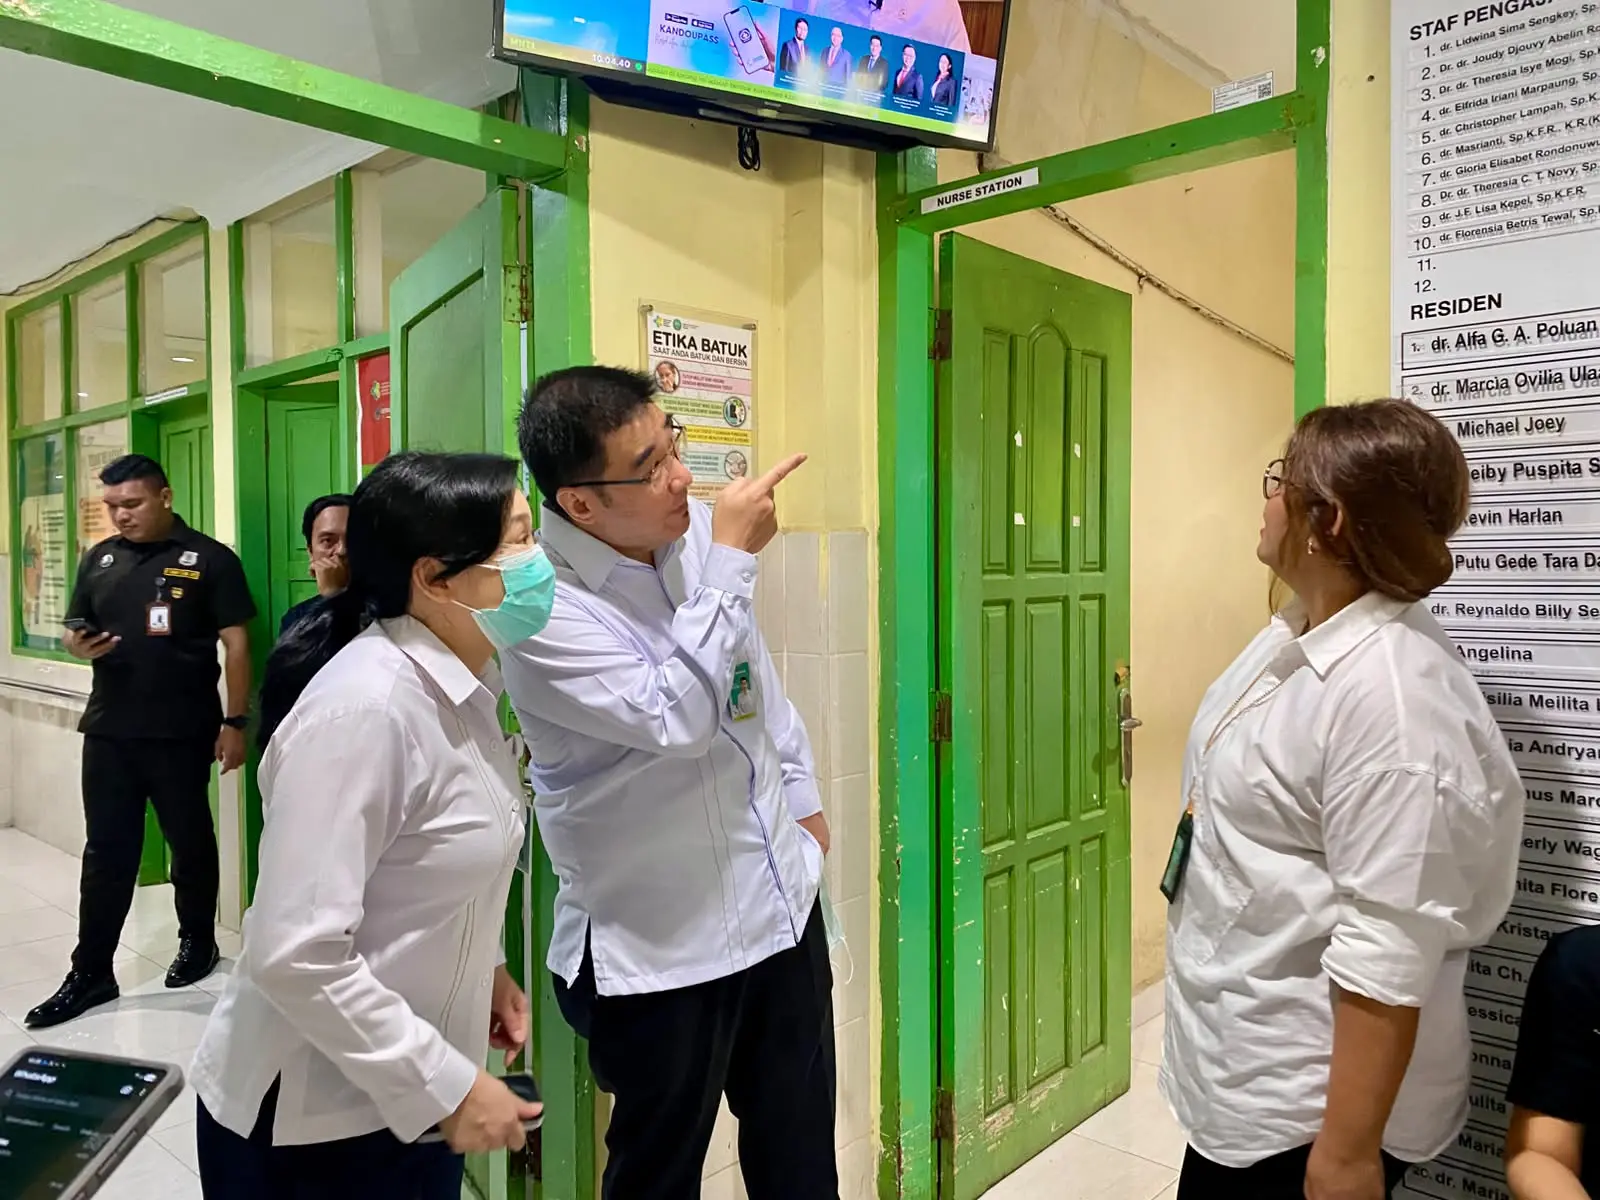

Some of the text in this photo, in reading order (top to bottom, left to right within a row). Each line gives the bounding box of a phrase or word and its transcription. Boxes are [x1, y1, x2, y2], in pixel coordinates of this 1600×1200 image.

[659, 23, 720, 45] KANDOUPASS
[1409, 14, 1459, 41] STAF
[1424, 46, 1436, 58] 1.
[1440, 42, 1452, 52] dr.
[1456, 29, 1496, 48] Lidwina
[1499, 23, 1526, 35] Sima
[1421, 67, 1436, 80] 2.
[1439, 63, 1454, 73] Dr.
[1456, 58, 1470, 68] dr.
[1472, 50, 1505, 64] Joudy
[1507, 39, 1545, 56] Djouvy
[1548, 29, 1584, 44] Abelin
[1421, 88, 1436, 102] 3.
[1439, 85, 1454, 95] Dr.
[1456, 80, 1469, 90] dr.
[1472, 70, 1517, 86] Theresia
[1520, 62, 1543, 75] Isye
[1579, 47, 1600, 59] Sp.
[1421, 110, 1436, 123] 4.
[1439, 106, 1452, 117] dr.
[1521, 76, 1579, 97] Marpaung,
[1421, 131, 1436, 144] 5.
[1439, 127, 1452, 137] dr.
[1455, 111, 1518, 133] Christopher
[1421, 152, 1436, 166] 6.
[1439, 148, 1452, 159] dr.
[1422, 173, 1436, 187] 7.
[1440, 169, 1452, 179] dr.
[1455, 162, 1487, 176] Gloria
[1489, 152, 1533, 168] Elisabet
[937, 176, 1022, 206] NURSE STATION
[1421, 194, 1436, 207] 8.
[1440, 190, 1454, 200] Dr.
[1456, 186, 1470, 196] dr.
[1473, 178, 1518, 193] Theresia
[1521, 174, 1532, 184] C.
[1536, 171, 1546, 181] T.
[1547, 166, 1578, 180] Novy,
[1421, 215, 1436, 229] 9.
[1439, 211, 1452, 222] dr.
[1475, 202, 1497, 214] Lisa
[1500, 196, 1533, 211] Kepel,
[1414, 205, 1600, 251] 10. dr. Florensia Betris Tewal, Sp.
[1417, 258, 1436, 272] 11.
[1414, 279, 1436, 293] 12.
[1410, 293, 1503, 320] RESIDEN
[653, 330, 748, 359] ETIKA BATUK
[1411, 319, 1597, 352] 1. dr. Alfa G. A. Poluan
[653, 346, 748, 367] SAAT ANDA BATUK DAN BERSIN
[1412, 365, 1600, 397] 2. dr. Marcia Ovilia Ula
[1457, 416, 1565, 435] Michael Joey
[1471, 464, 1506, 482] eiby
[1513, 459, 1582, 479] Puspita
[1508, 508, 1563, 524] Harlan
[1455, 554, 1490, 569] Putu
[1495, 553, 1538, 569] Gede
[1542, 552, 1578, 568] Tara
[1431, 603, 1600, 619] dr. Reynaldo Billy Se
[1456, 645, 1533, 662] Angelina
[1529, 694, 1589, 711] Meilita
[1508, 738, 1600, 761] ia Andrya
[1522, 837, 1558, 855] erly
[1551, 883, 1598, 903] Flore
[1497, 920, 1558, 941] Krista
[1497, 965, 1528, 983] Ch.
[1467, 1005, 1521, 1027] essic
[1469, 1094, 1507, 1114] ulita
[1435, 1171, 1456, 1188] dr.
